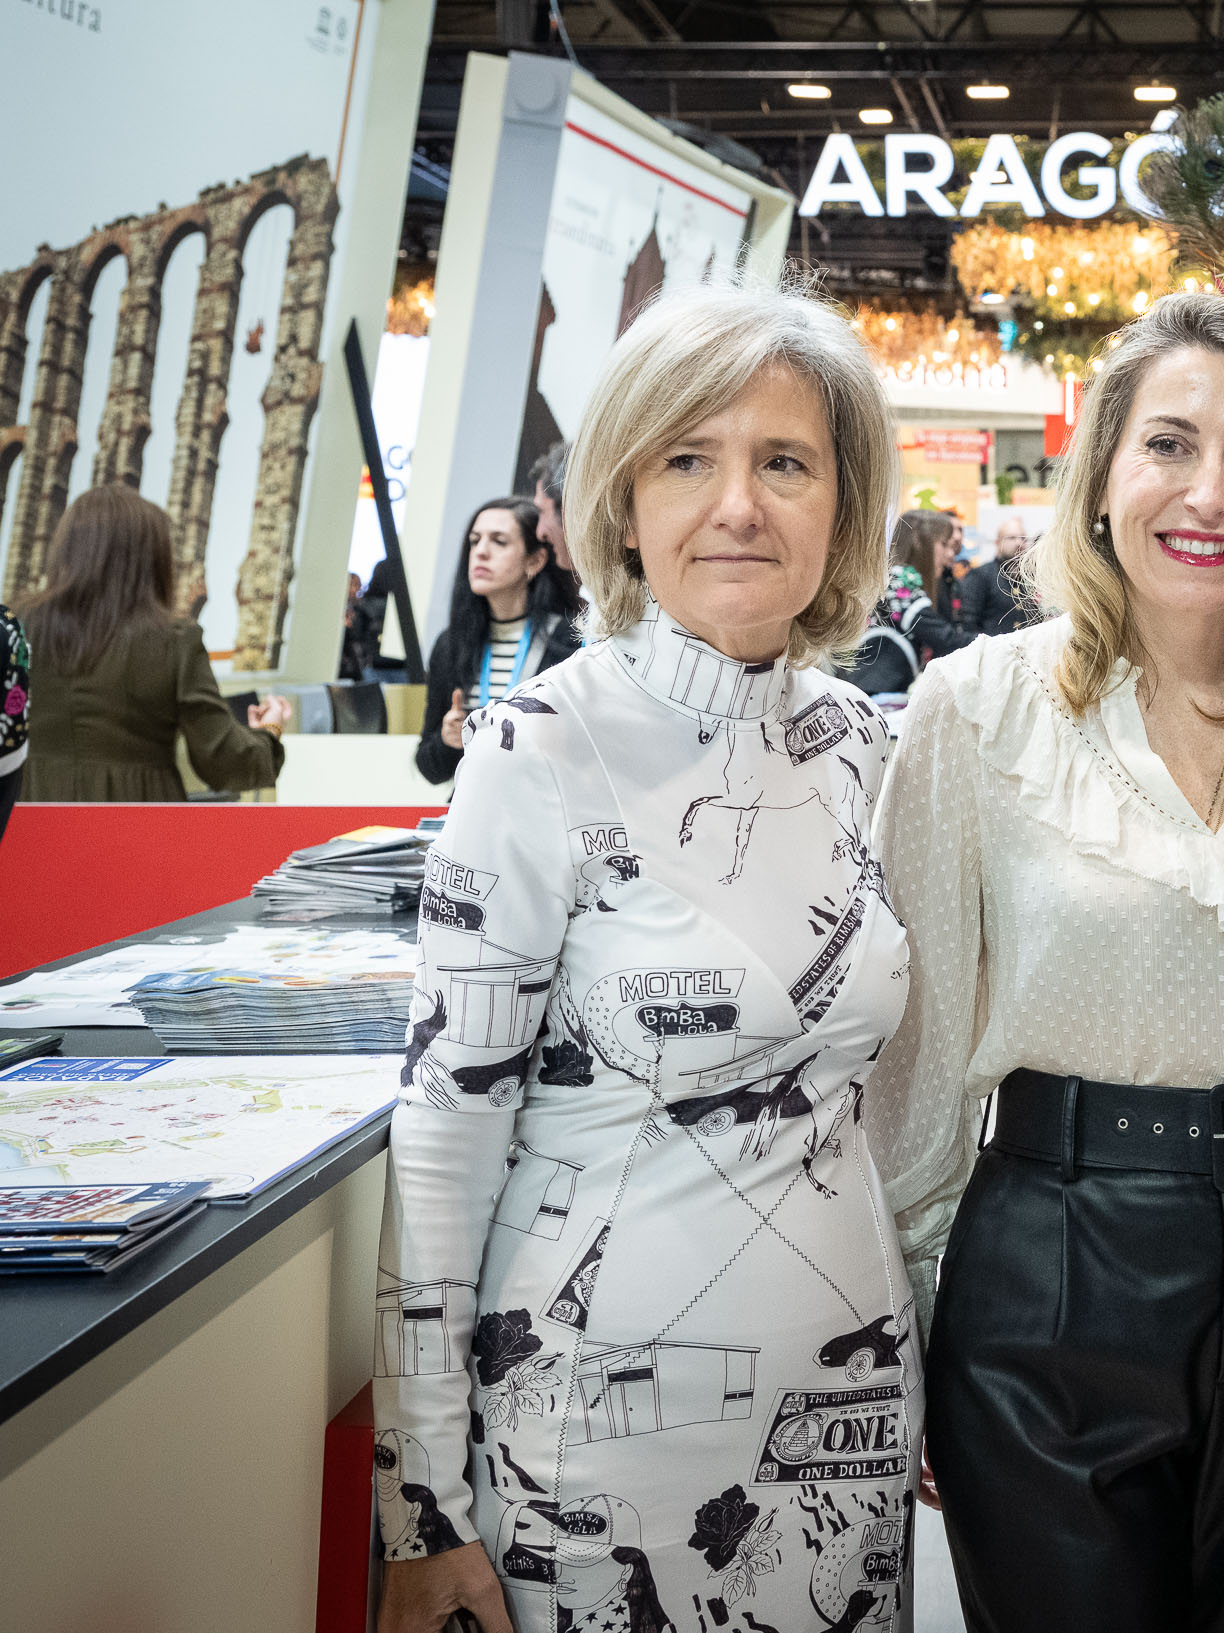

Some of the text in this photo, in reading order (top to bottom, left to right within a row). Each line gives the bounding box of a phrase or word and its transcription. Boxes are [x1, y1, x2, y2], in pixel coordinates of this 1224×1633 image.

[619, 970, 732, 1003] MOTEL
[823, 1412, 899, 1455] ONE
[798, 1458, 907, 1480] ONE DOLLAR
